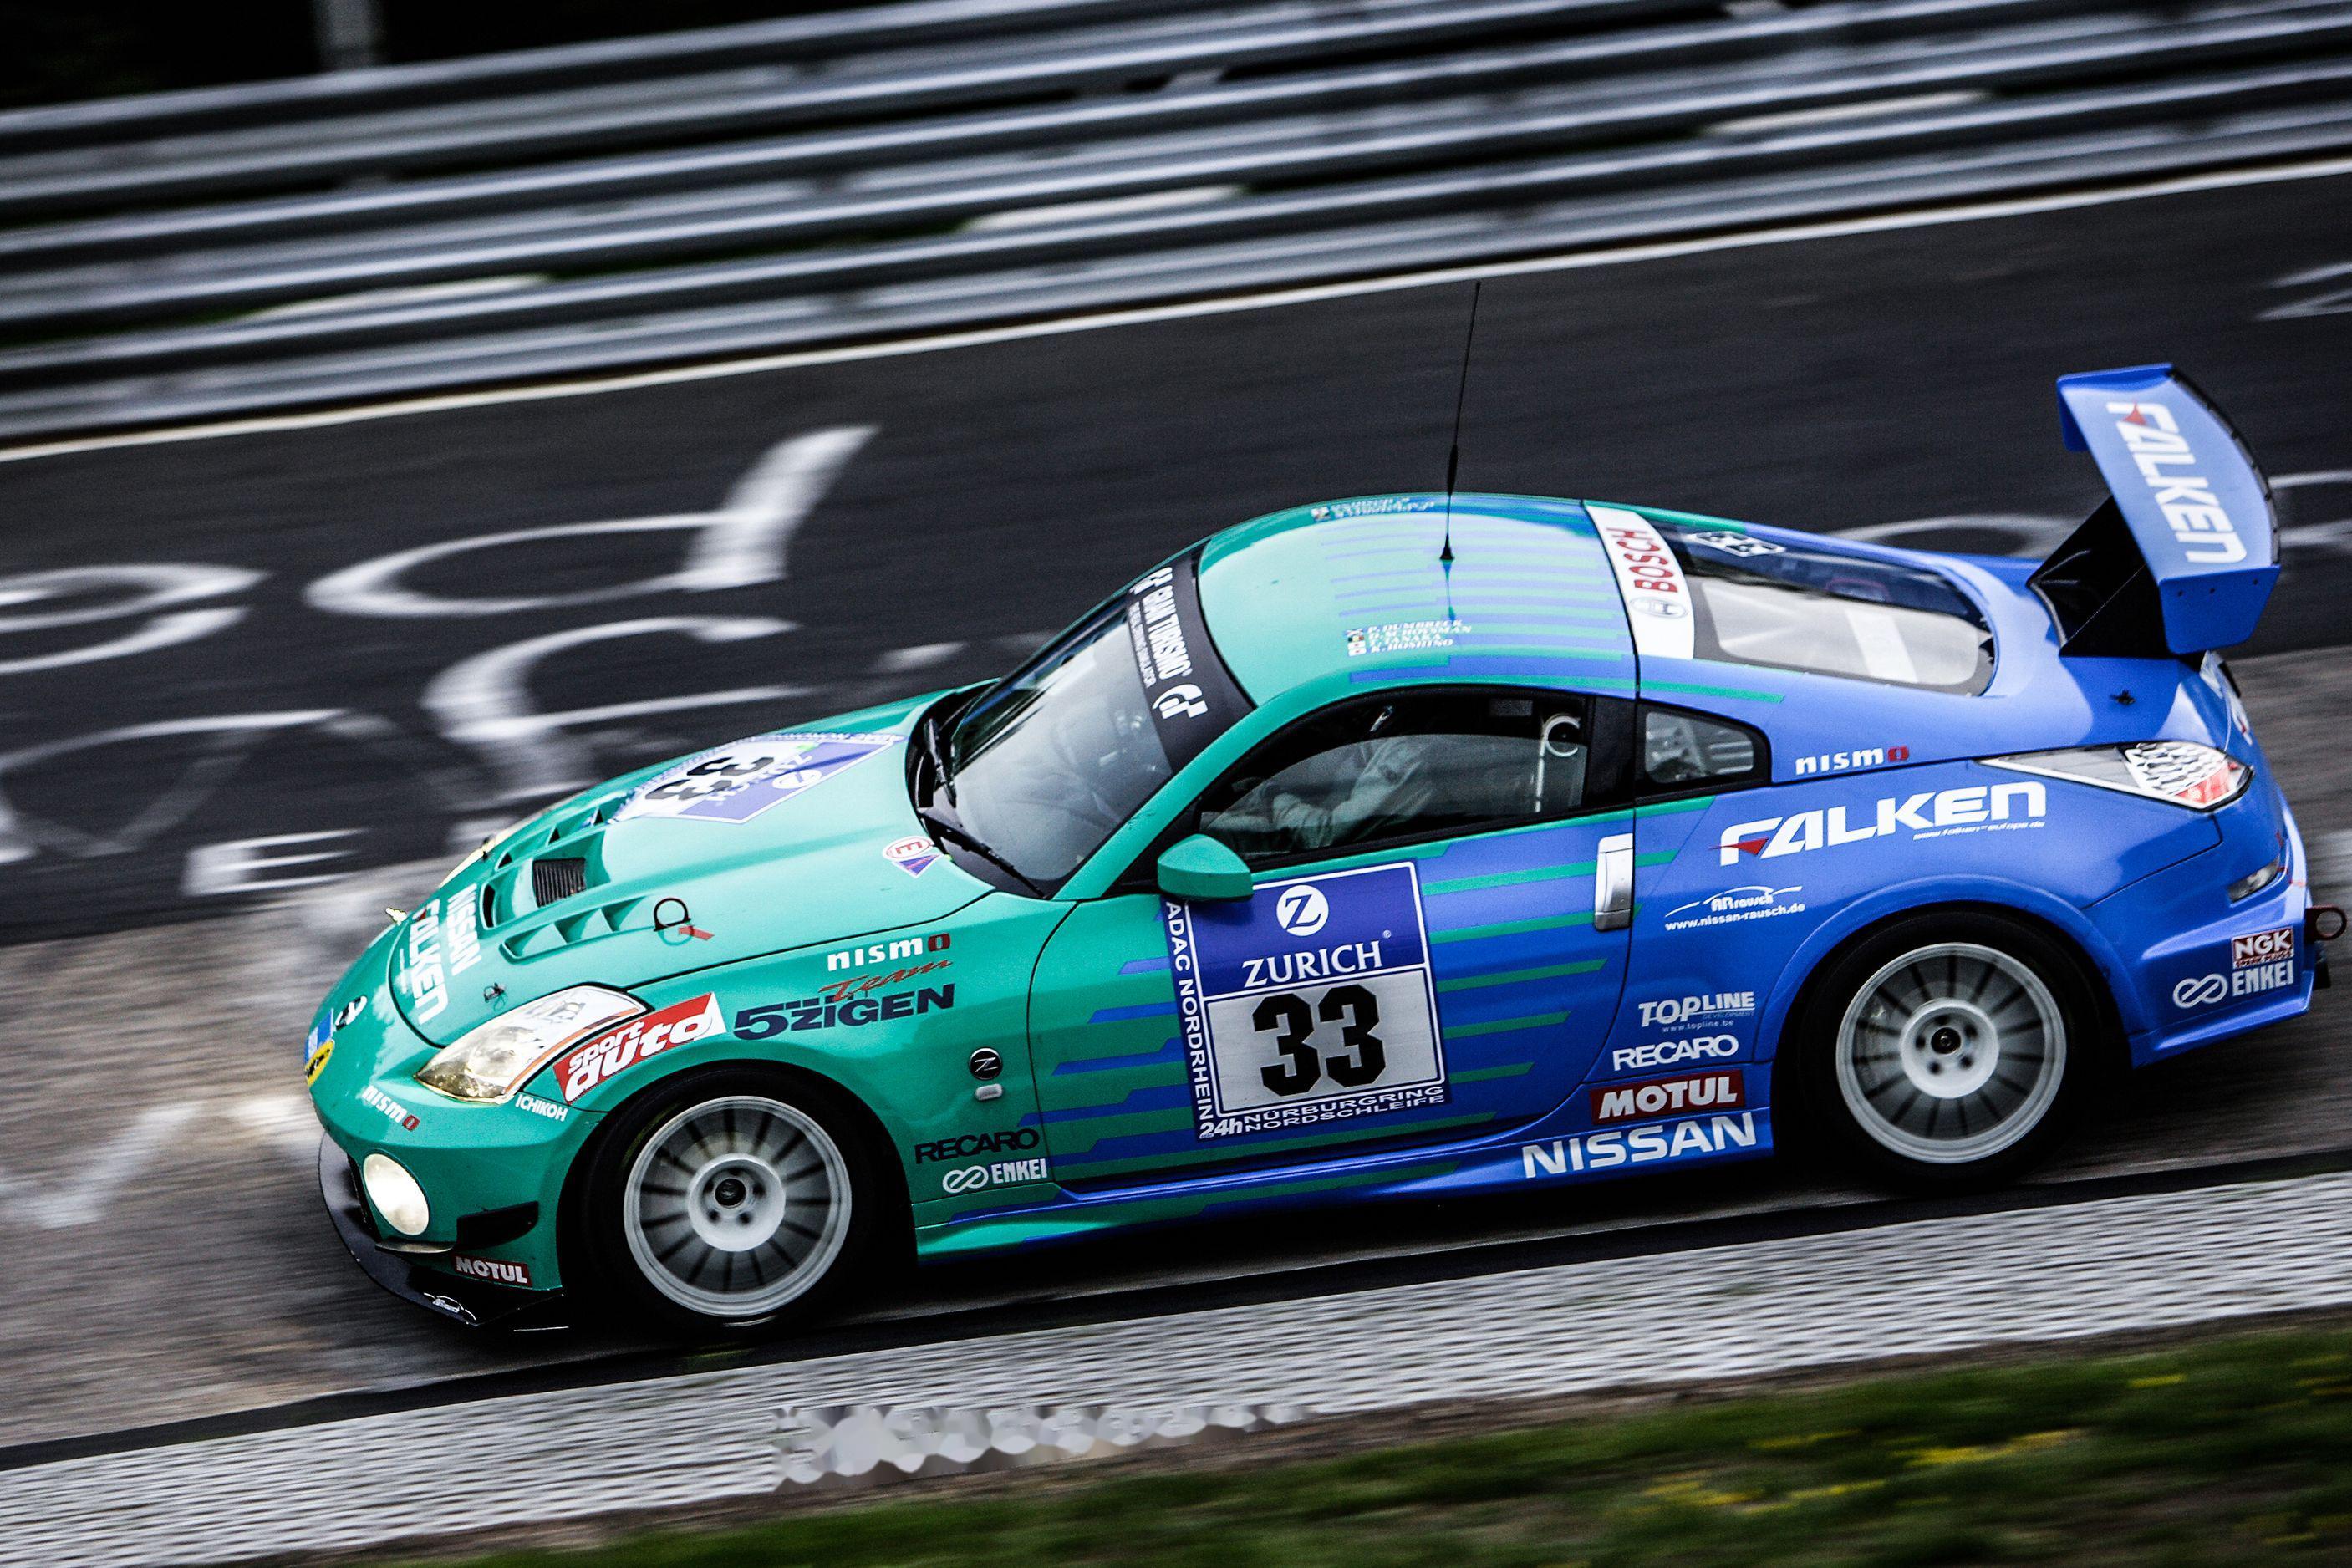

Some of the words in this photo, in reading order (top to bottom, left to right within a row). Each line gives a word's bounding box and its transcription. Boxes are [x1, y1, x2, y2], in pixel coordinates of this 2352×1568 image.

[2106, 401, 2247, 563] FALKEN
[1606, 528, 1678, 593] BOSCH
[1795, 746, 1909, 775] nismo
[1718, 781, 2046, 867] FALKEN
[447, 883, 481, 975] NISSAN
[1665, 903, 1805, 930] www.nissan-rausch.de
[410, 899, 448, 1025] FALKEN
[827, 933, 951, 971] nismo
[1242, 940, 1383, 989] ZURICH
[2235, 930, 2291, 960] NGK
[2232, 960, 2293, 996] ENKEI
[734, 984, 955, 1040] 5ZIGEN
[1166, 902, 1191, 972] ADAC
[1179, 979, 1214, 1121] NORDRHEIN
[1638, 991, 1755, 1027] TOPLINE
[565, 1013, 714, 1102] auto
[568, 1021, 644, 1074] sport
[1252, 984, 1387, 1097] 33
[1613, 1035, 1739, 1071] RECARO
[361, 1086, 420, 1132] nismo
[515, 1093, 568, 1122] ICHIKOH
[1199, 1117, 1243, 1139] 24h
[1244, 1087, 1444, 1123] NÜRBURGRING
[1245, 1094, 1445, 1132] NORDSCHLEIFE
[1599, 1076, 1738, 1119] MOTUL
[914, 1128, 1040, 1163] RECARO
[1521, 1112, 1757, 1178] NISSAN
[991, 1158, 1047, 1184] ENKEI
[456, 1256, 527, 1283] MOTUL
